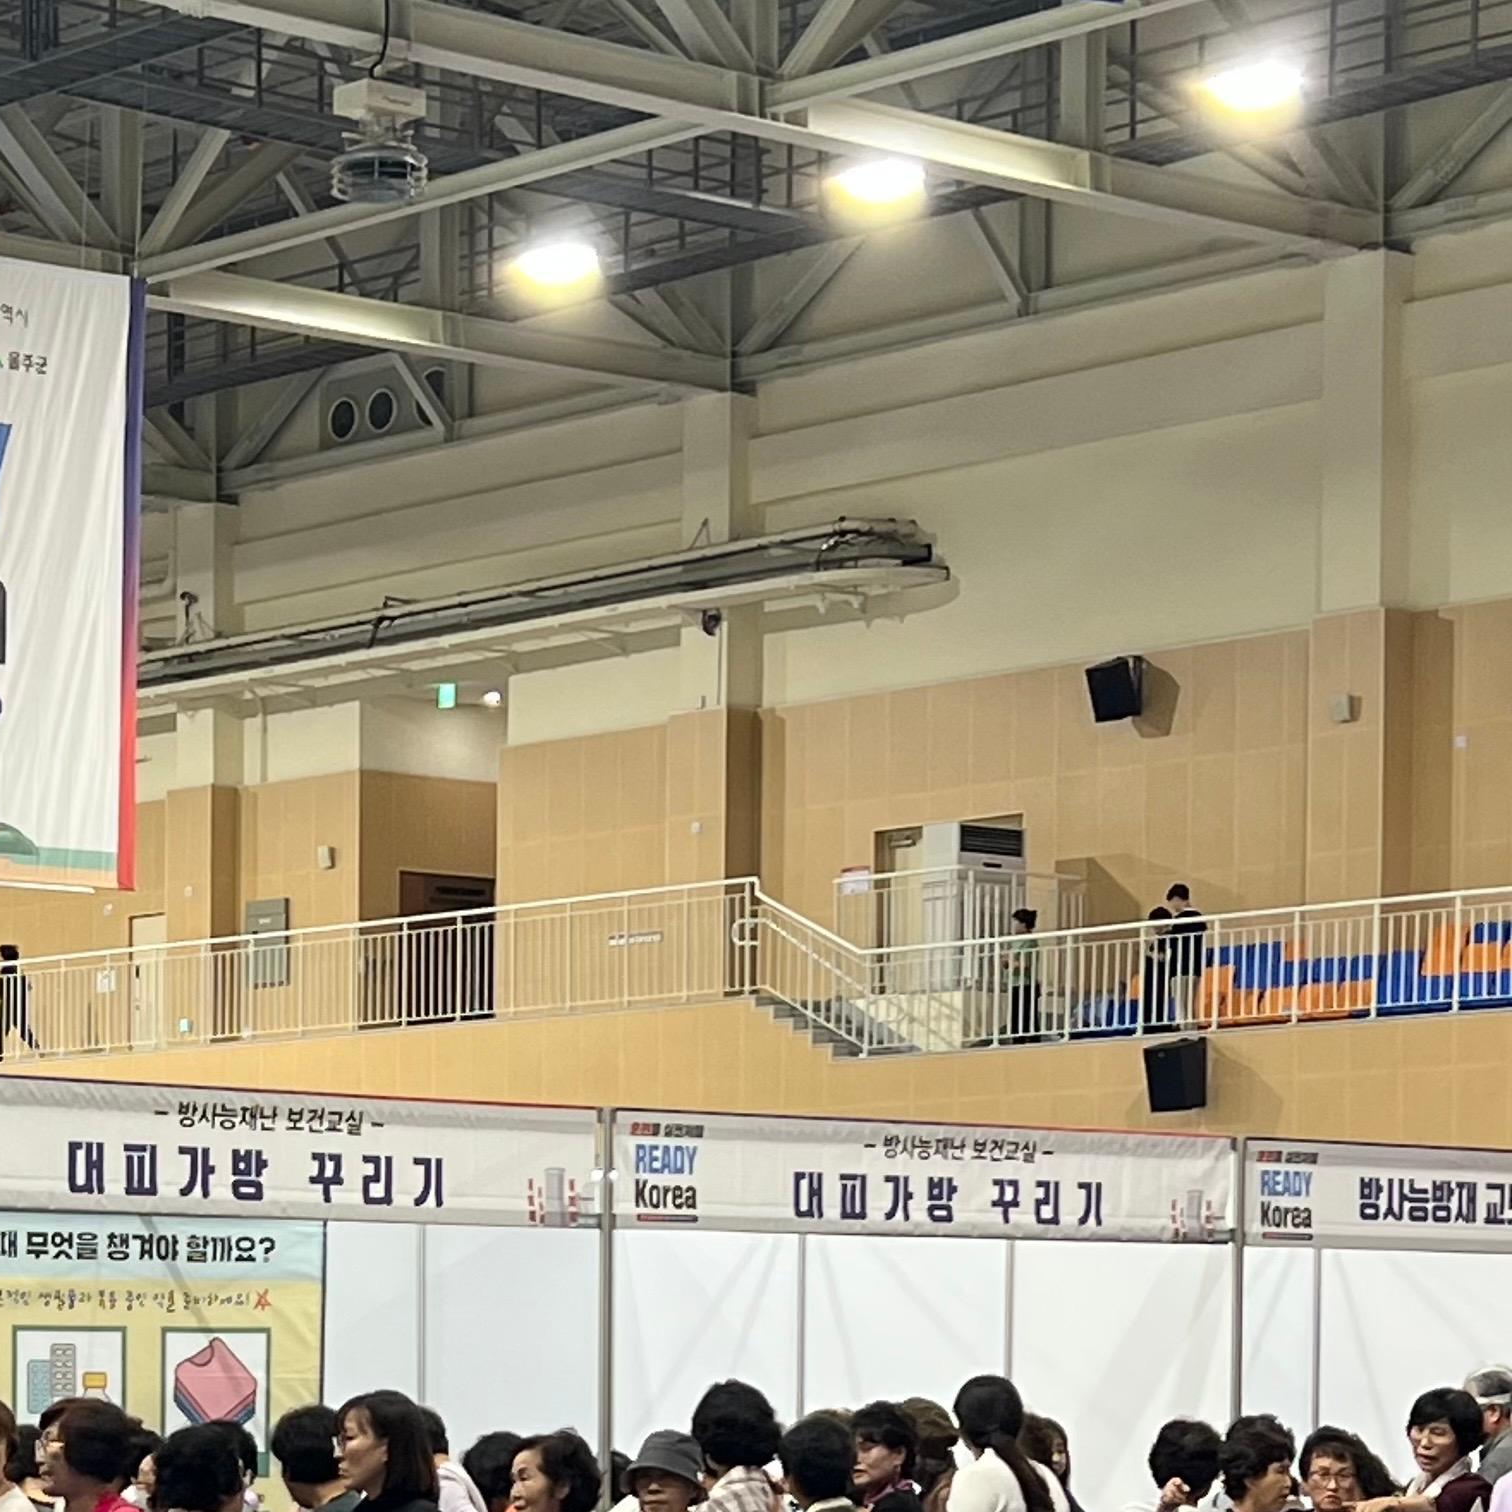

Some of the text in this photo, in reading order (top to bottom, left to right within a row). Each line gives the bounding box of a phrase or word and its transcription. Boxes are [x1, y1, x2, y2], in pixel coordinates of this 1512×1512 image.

[7, 351, 48, 375] 울주군
[178, 1101, 278, 1131] 방사능재난
[285, 1106, 364, 1135] 보건교실
[635, 1144, 697, 1175] READY
[883, 1135, 965, 1161] 방사능재난
[972, 1138, 1037, 1164] 보건교실
[67, 1140, 444, 1208] 대피가방 꾸리기
[1260, 1169, 1313, 1197] READY
[635, 1179, 697, 1210] Korea
[793, 1171, 1103, 1227] 대피가방 꾸리기
[1359, 1176, 1512, 1226] 방사능방재 교
[1260, 1200, 1313, 1229] Korea
[26, 1231, 99, 1261] 무엇을
[107, 1232, 179, 1262] 챙겨야
[186, 1235, 276, 1264] 할까요?
